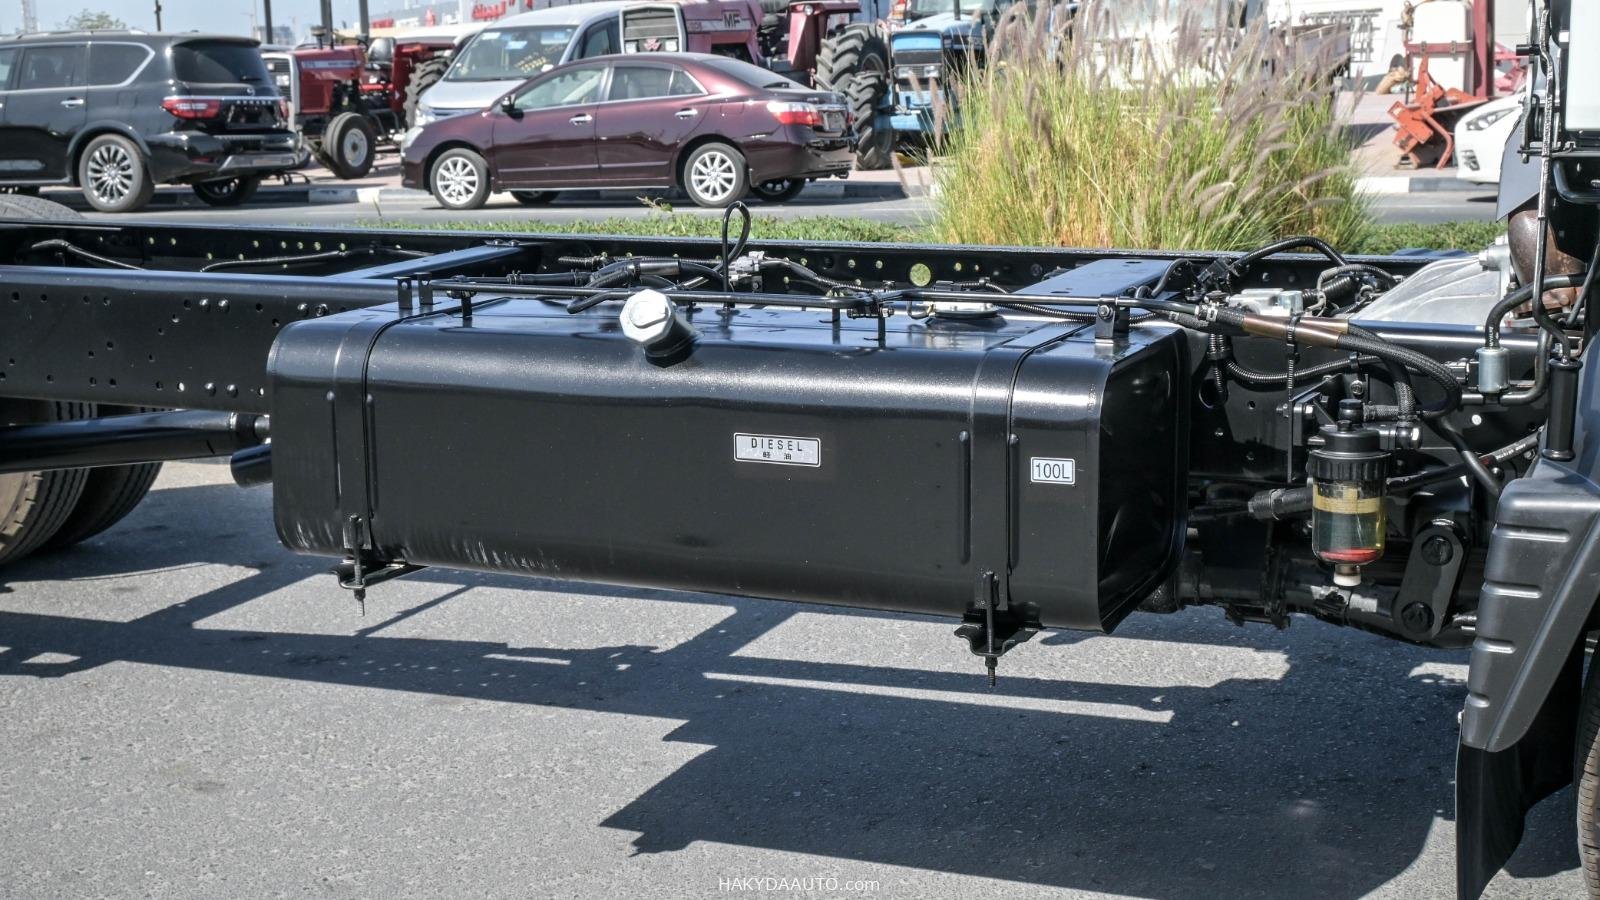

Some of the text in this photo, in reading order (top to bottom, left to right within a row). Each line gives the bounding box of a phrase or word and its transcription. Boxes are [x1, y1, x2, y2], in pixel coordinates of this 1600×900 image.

[723, 12, 741, 28] MF
[751, 438, 803, 452] DIESEL
[1035, 462, 1071, 479] 100L
